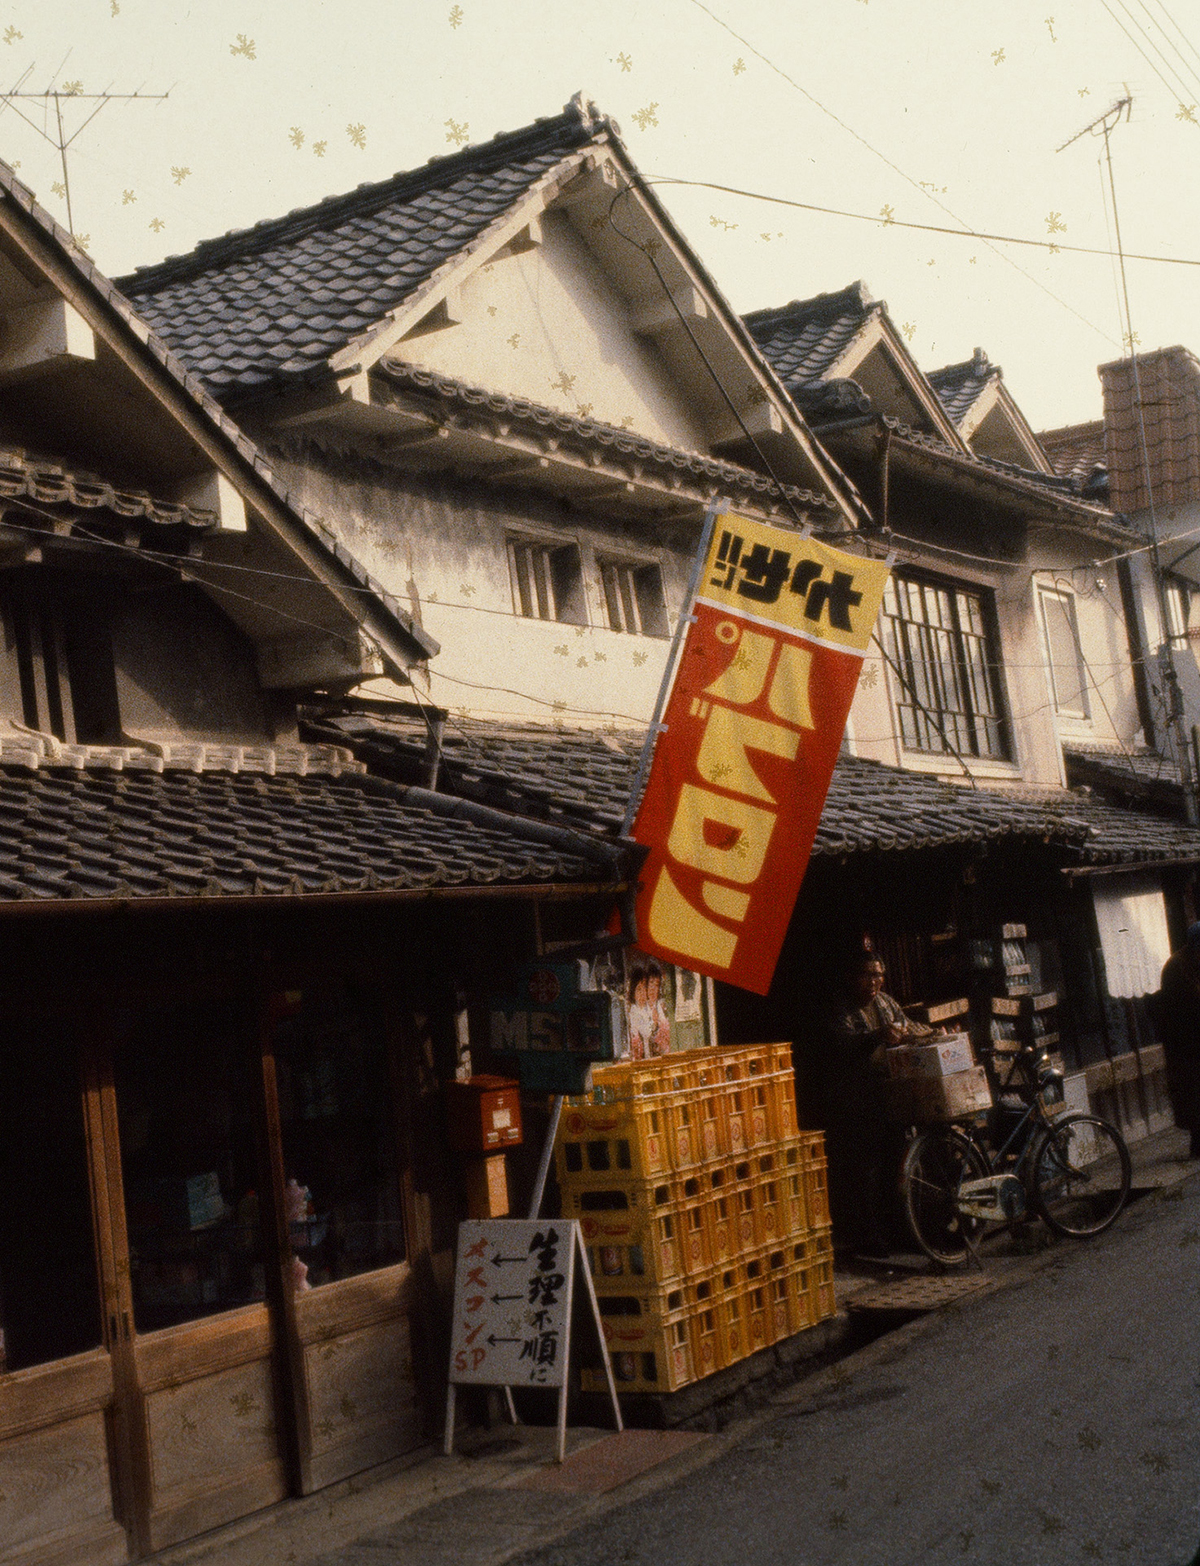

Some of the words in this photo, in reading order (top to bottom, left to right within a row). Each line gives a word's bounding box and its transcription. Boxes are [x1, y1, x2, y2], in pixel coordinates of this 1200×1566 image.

[519, 1227, 565, 1383] 生理不順に
